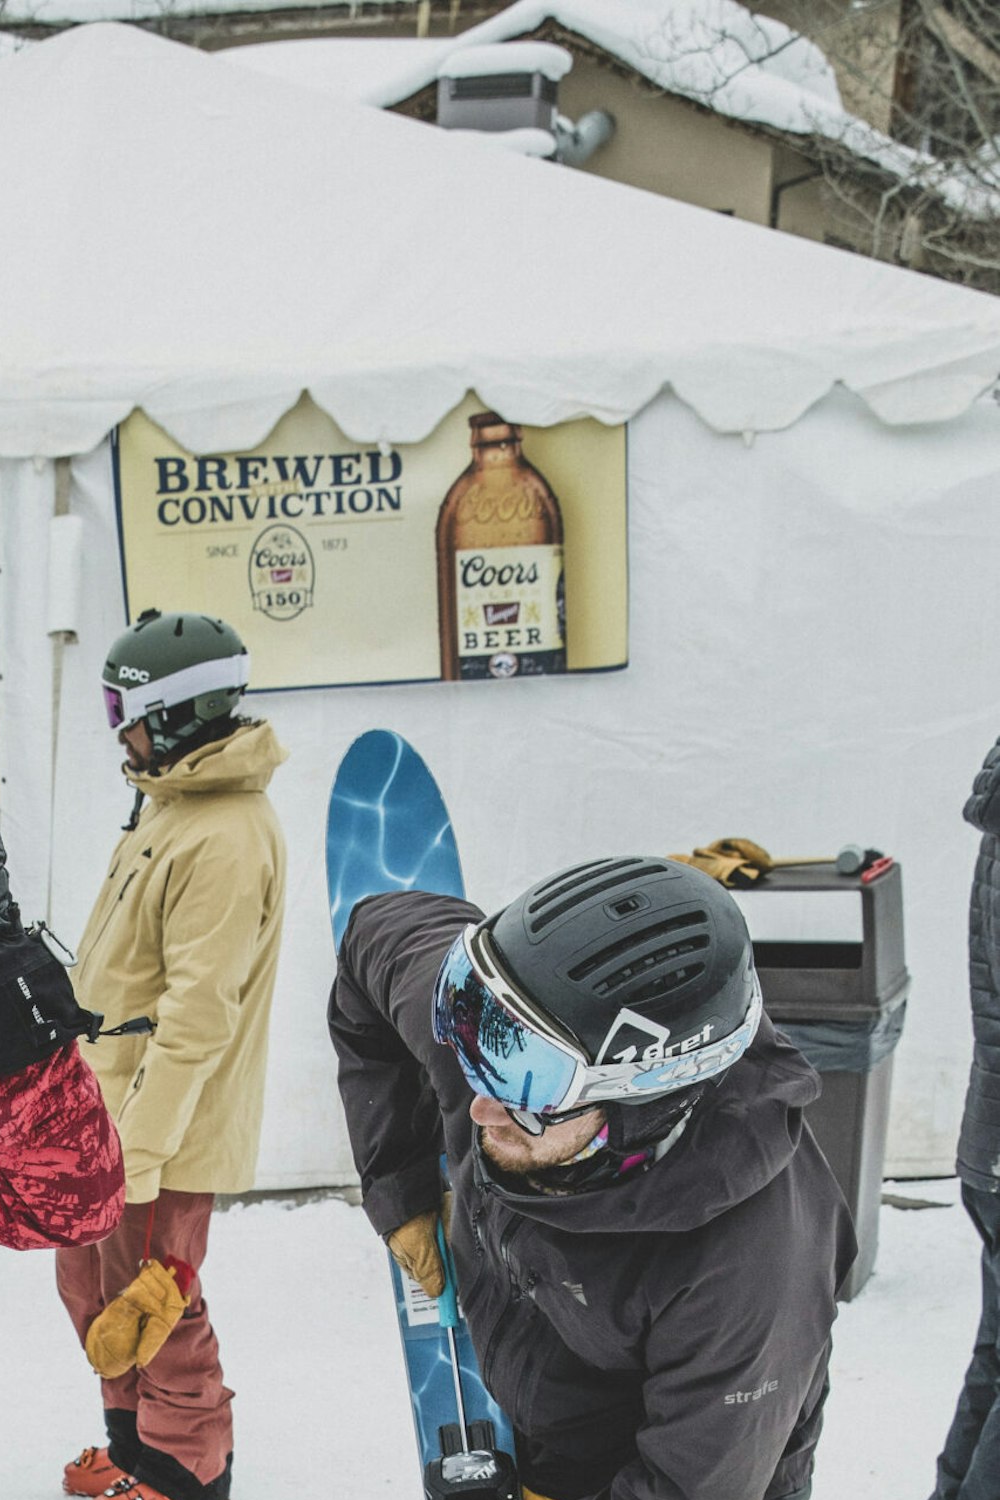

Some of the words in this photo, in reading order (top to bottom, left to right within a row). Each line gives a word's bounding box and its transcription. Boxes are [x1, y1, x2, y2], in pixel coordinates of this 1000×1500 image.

[154, 451, 403, 494] BREWED
[157, 486, 402, 526] CONVICTION
[205, 544, 238, 558] SINCE
[322, 538, 348, 551] 1873
[254, 549, 307, 568] Coors
[460, 555, 540, 589] Coors
[265, 592, 301, 607] 150
[464, 627, 542, 650] BEER
[724, 1379, 779, 1405] strafe
